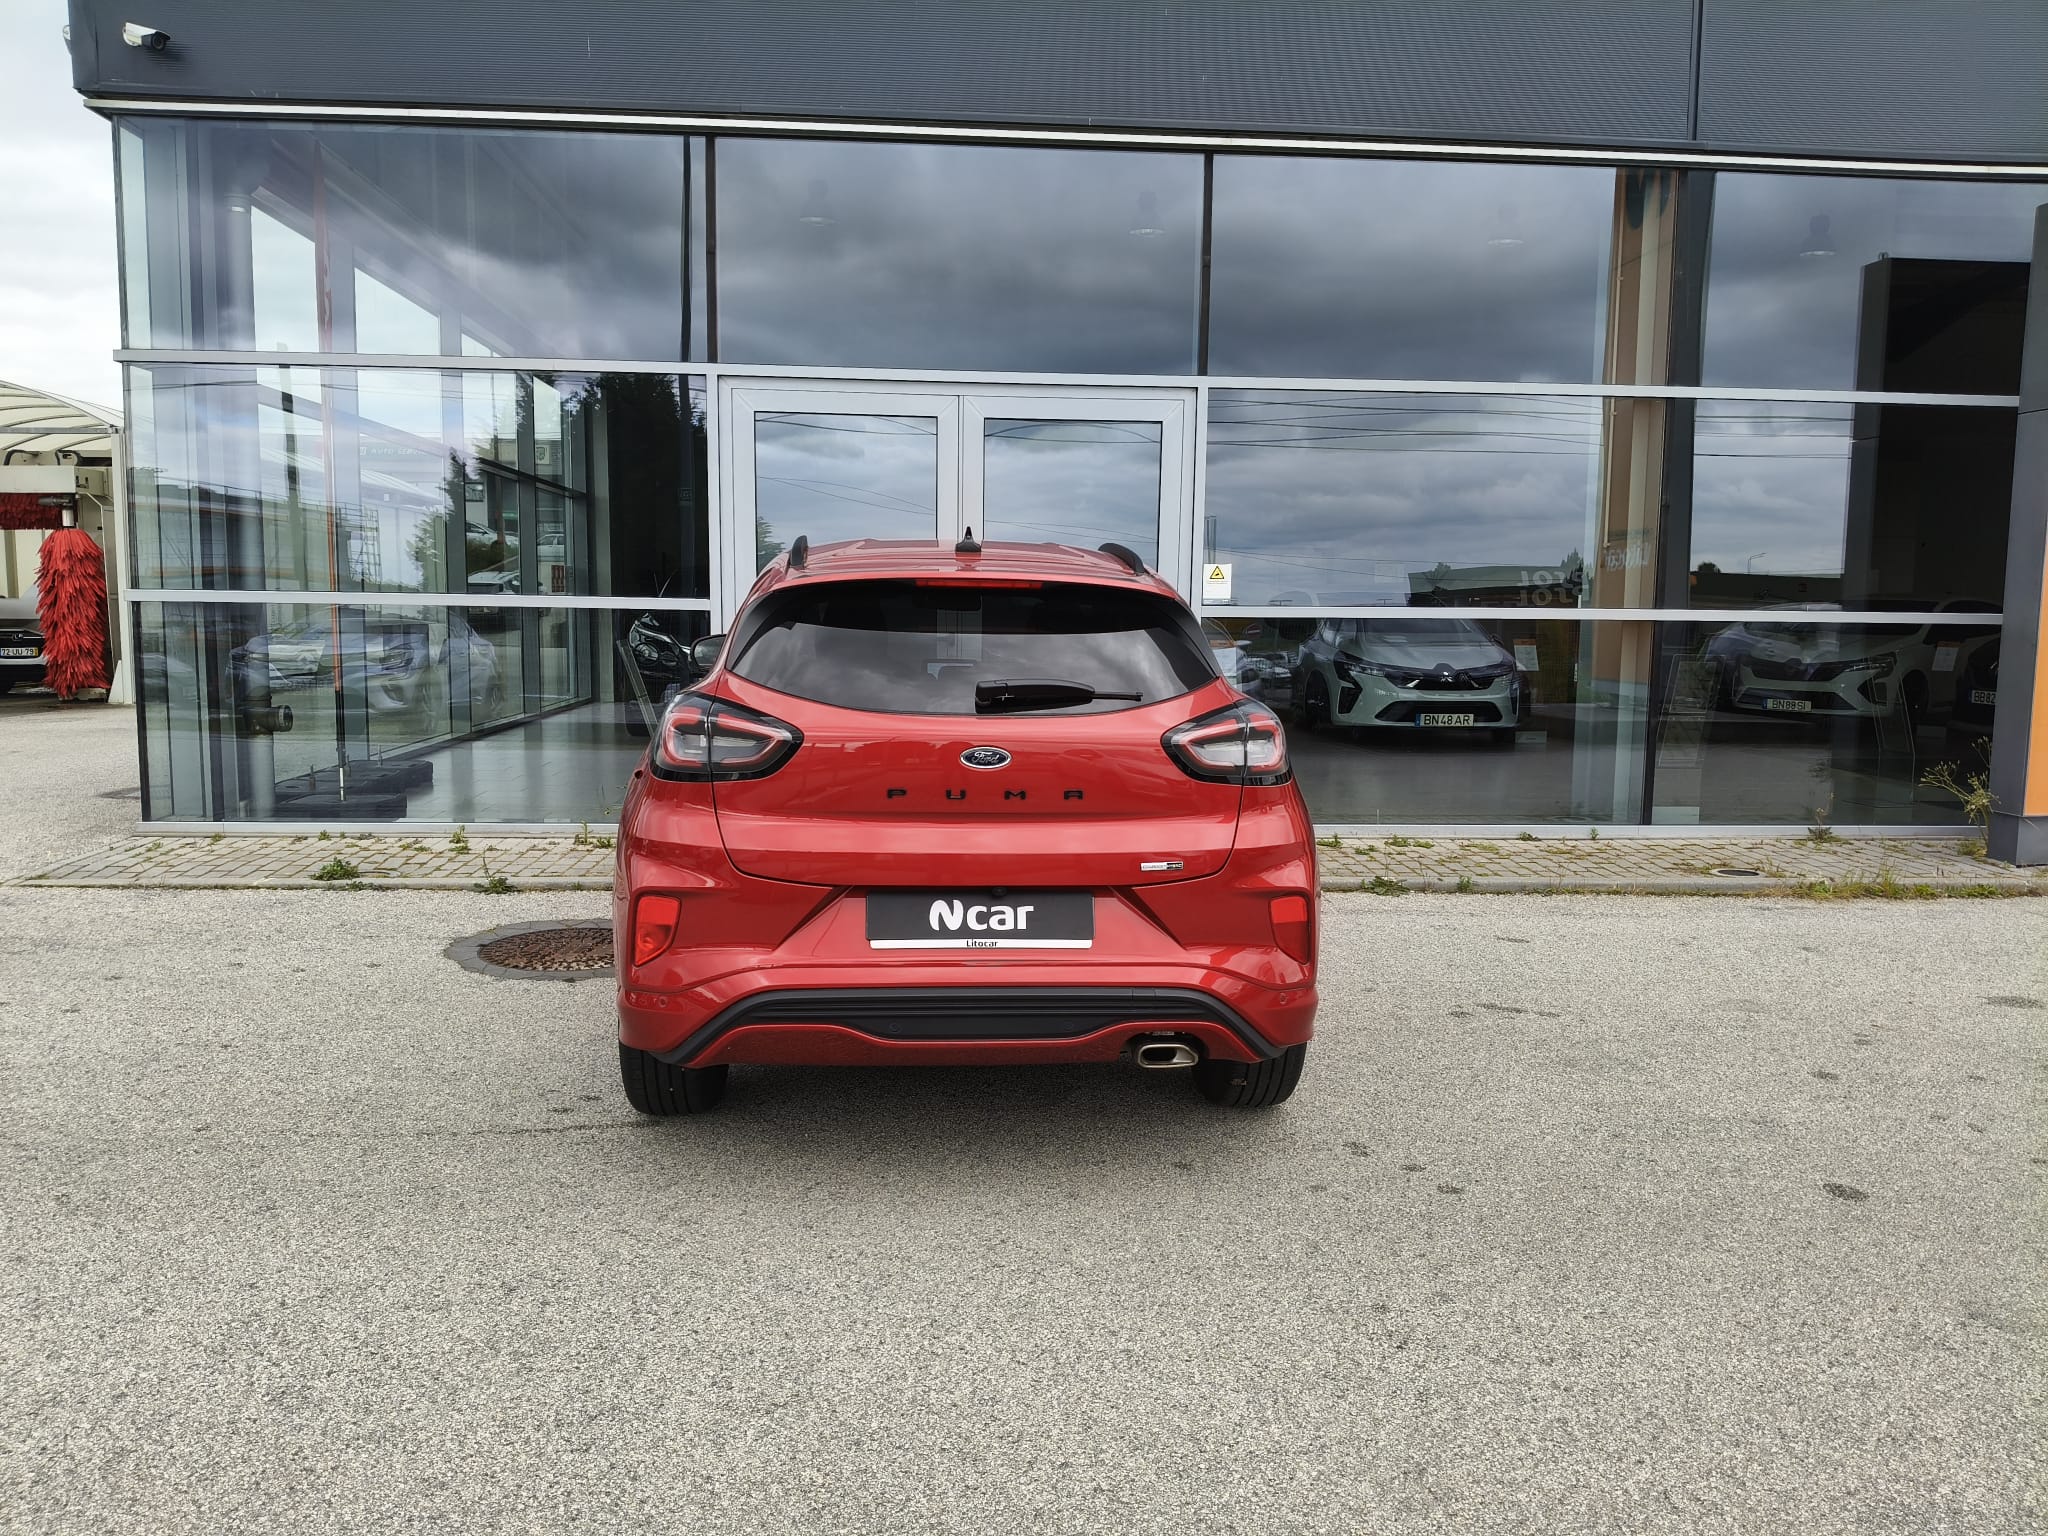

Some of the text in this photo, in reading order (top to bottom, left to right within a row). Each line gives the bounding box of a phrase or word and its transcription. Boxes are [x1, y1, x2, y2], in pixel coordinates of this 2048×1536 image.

[972, 751, 1000, 764] Ford
[929, 899, 1035, 931] Ncar
[966, 938, 999, 948] Litocar
